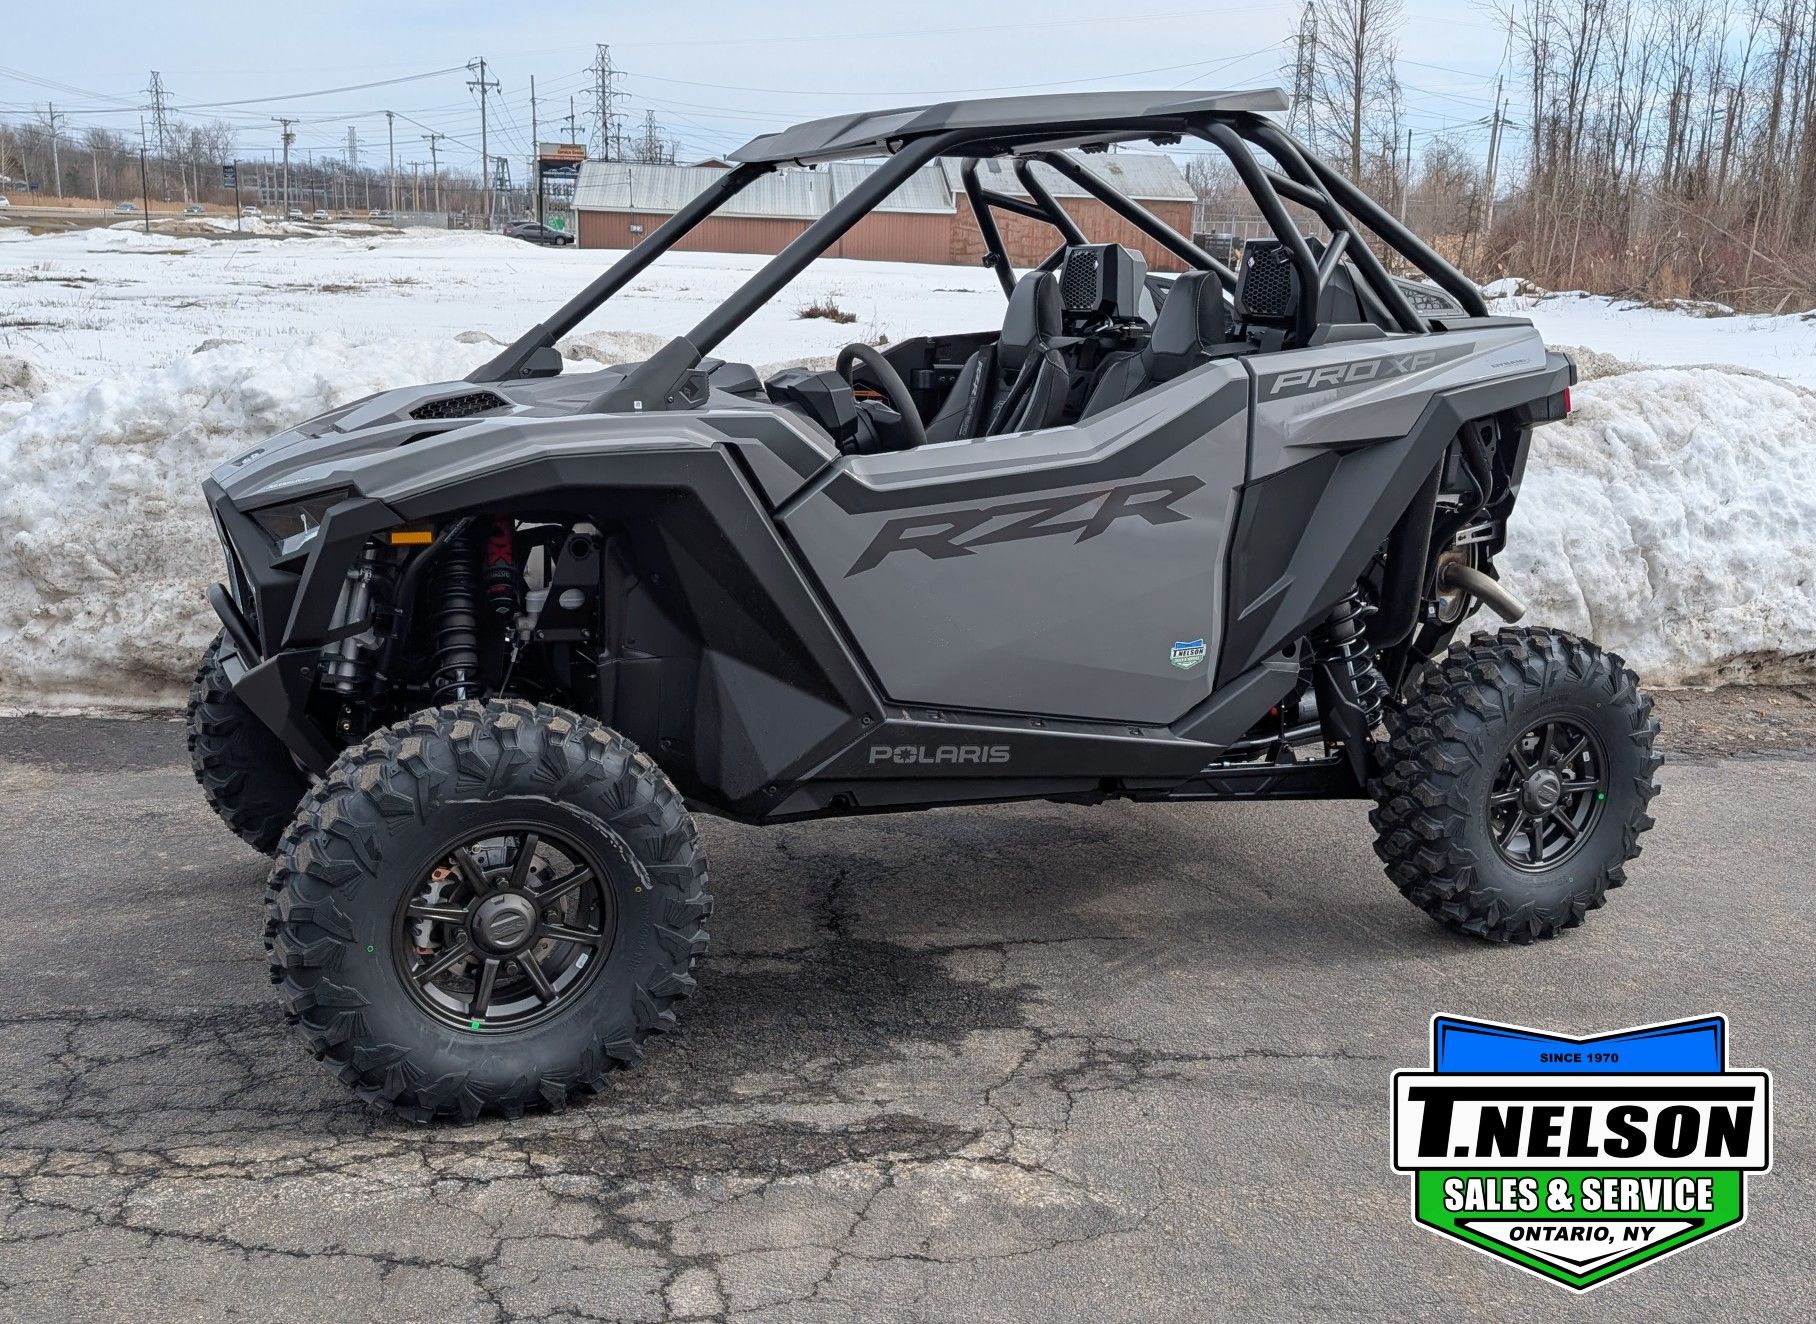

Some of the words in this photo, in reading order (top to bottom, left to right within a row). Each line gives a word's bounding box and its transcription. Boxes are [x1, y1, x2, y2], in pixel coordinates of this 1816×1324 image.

[1270, 360, 1382, 395] PRO
[1384, 352, 1436, 374] XP
[843, 475, 1207, 579] RZR
[869, 744, 1010, 764] POLARIS
